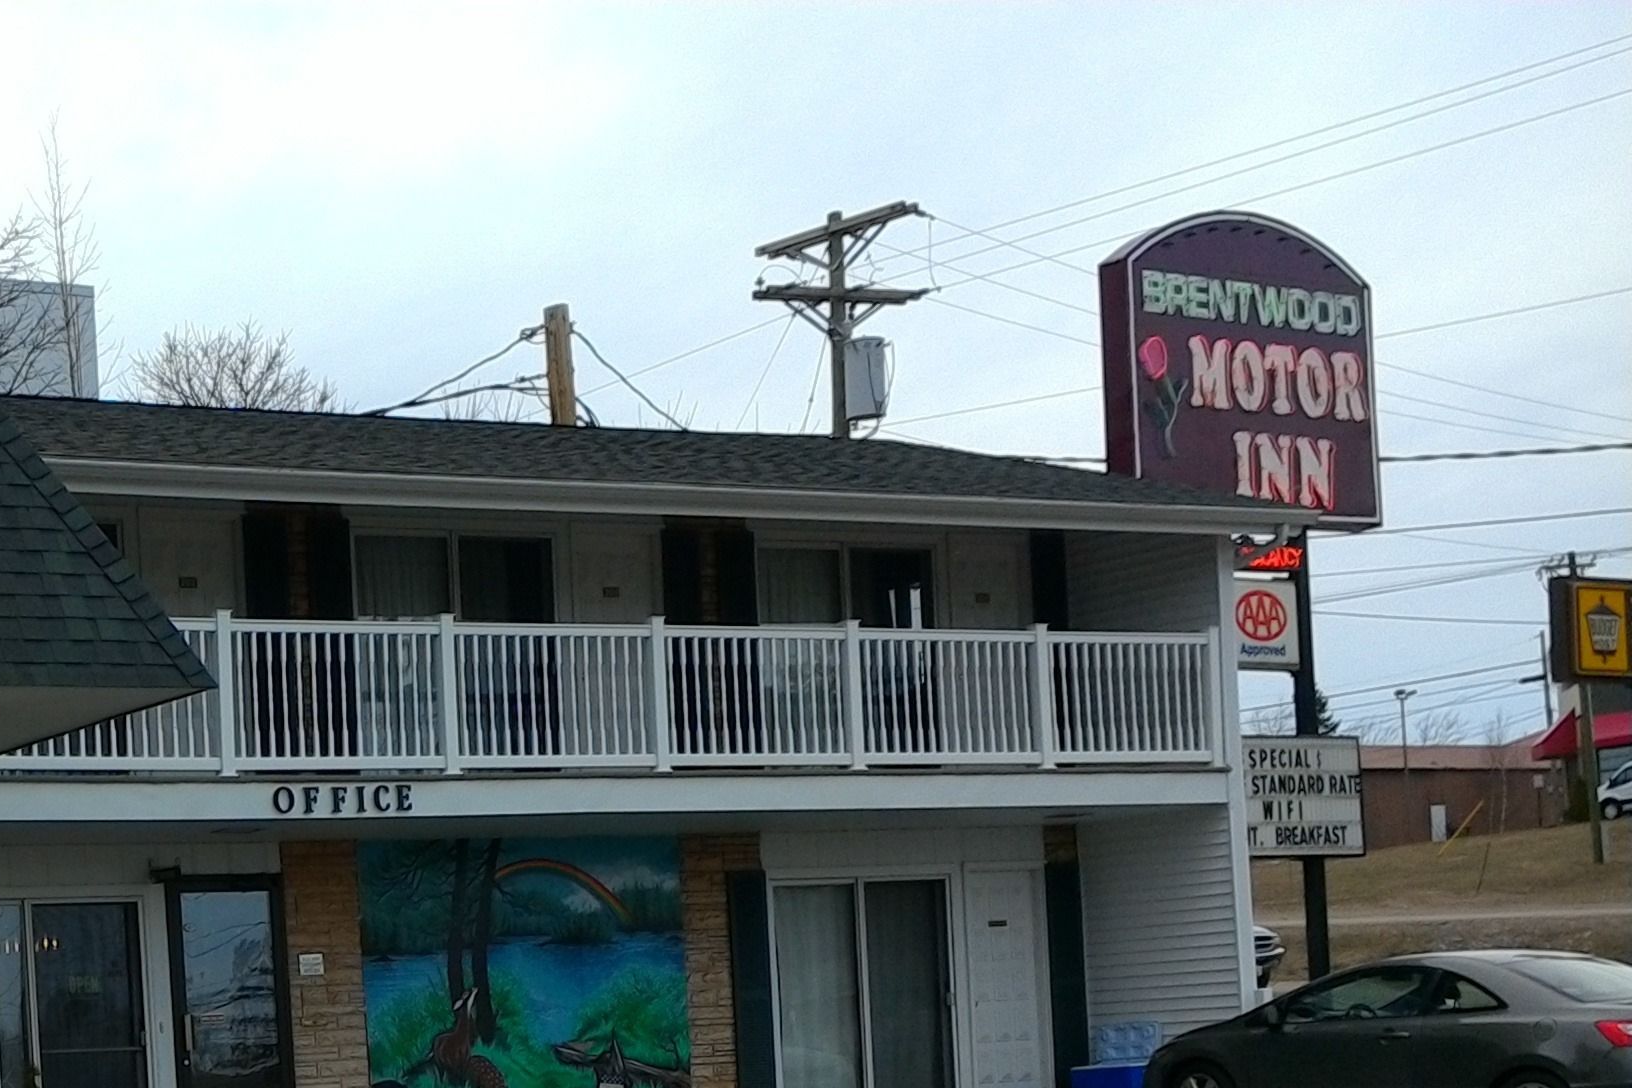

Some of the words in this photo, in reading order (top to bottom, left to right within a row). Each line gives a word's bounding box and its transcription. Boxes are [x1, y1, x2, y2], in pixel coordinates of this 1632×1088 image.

[1141, 269, 1361, 336] BRENTWOOD
[1187, 334, 1368, 423] MOTOR
[1232, 430, 1336, 512] INN
[1240, 593, 1284, 638] AAA
[1241, 643, 1286, 657] Approved
[272, 784, 413, 814] OFFICE
[1252, 774, 1325, 796] STANDARD
[1275, 825, 1347, 847] BREAKFAST
[68, 976, 98, 993] OPEN
